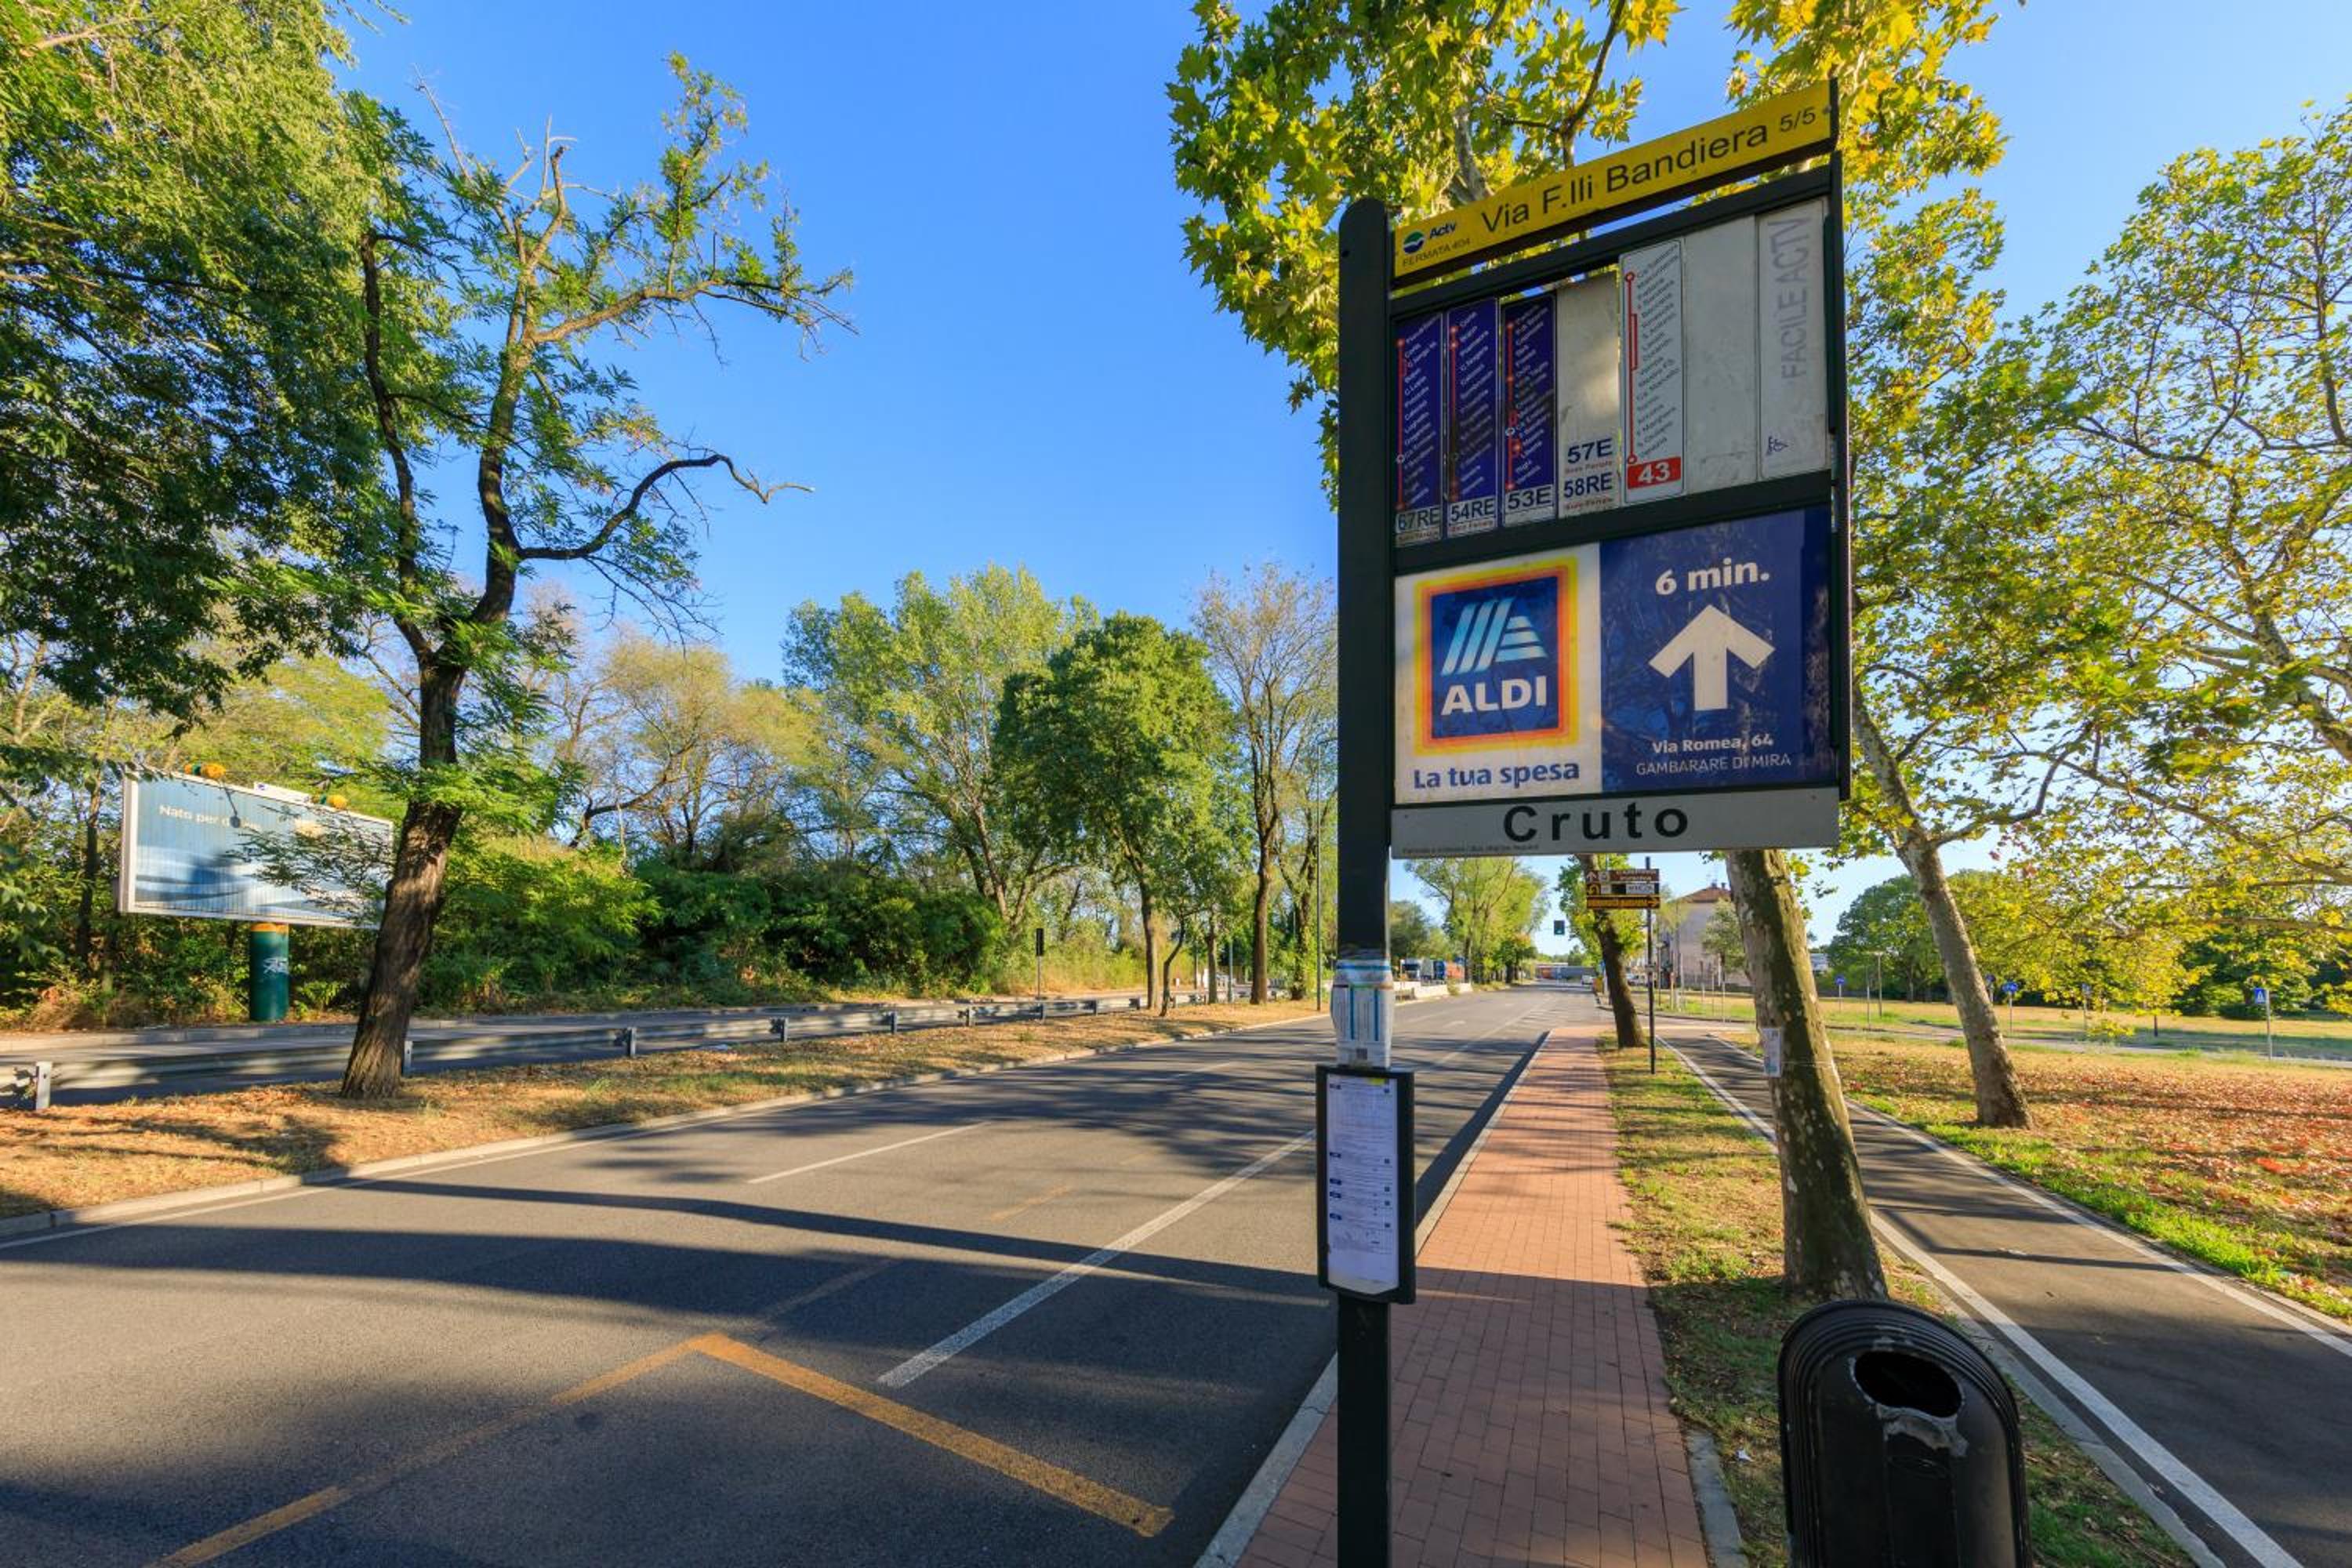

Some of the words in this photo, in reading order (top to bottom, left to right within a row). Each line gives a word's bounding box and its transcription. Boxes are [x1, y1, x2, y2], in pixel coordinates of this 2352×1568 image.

[1481, 204, 1530, 234] Via
[1543, 180, 1593, 216] F.lli
[1606, 126, 1769, 193] Bandiera
[1780, 107, 1816, 132] 5/5
[1429, 223, 1456, 239] Actv
[1403, 242, 1451, 266] FERMATA
[1568, 438, 1613, 464] 57E
[1637, 461, 1671, 484] 43
[1563, 472, 1613, 498] 58RE
[1450, 498, 1495, 522] 54RE
[1508, 486, 1551, 510] 53E
[1655, 568, 1676, 596] 6
[1687, 557, 1770, 591] min.
[1440, 674, 1548, 717] ALDI
[1652, 740, 1679, 753] Via
[1682, 737, 1748, 753] Romea,
[1751, 733, 1774, 748] 64
[1414, 767, 1444, 789] La
[1448, 764, 1493, 786] tua
[1499, 762, 1580, 789] spesa
[1636, 757, 1729, 776] GAMBARARE
[1751, 753, 1791, 768] MIRA
[158, 804, 193, 820] Nato
[1503, 800, 1690, 843] Cruto
